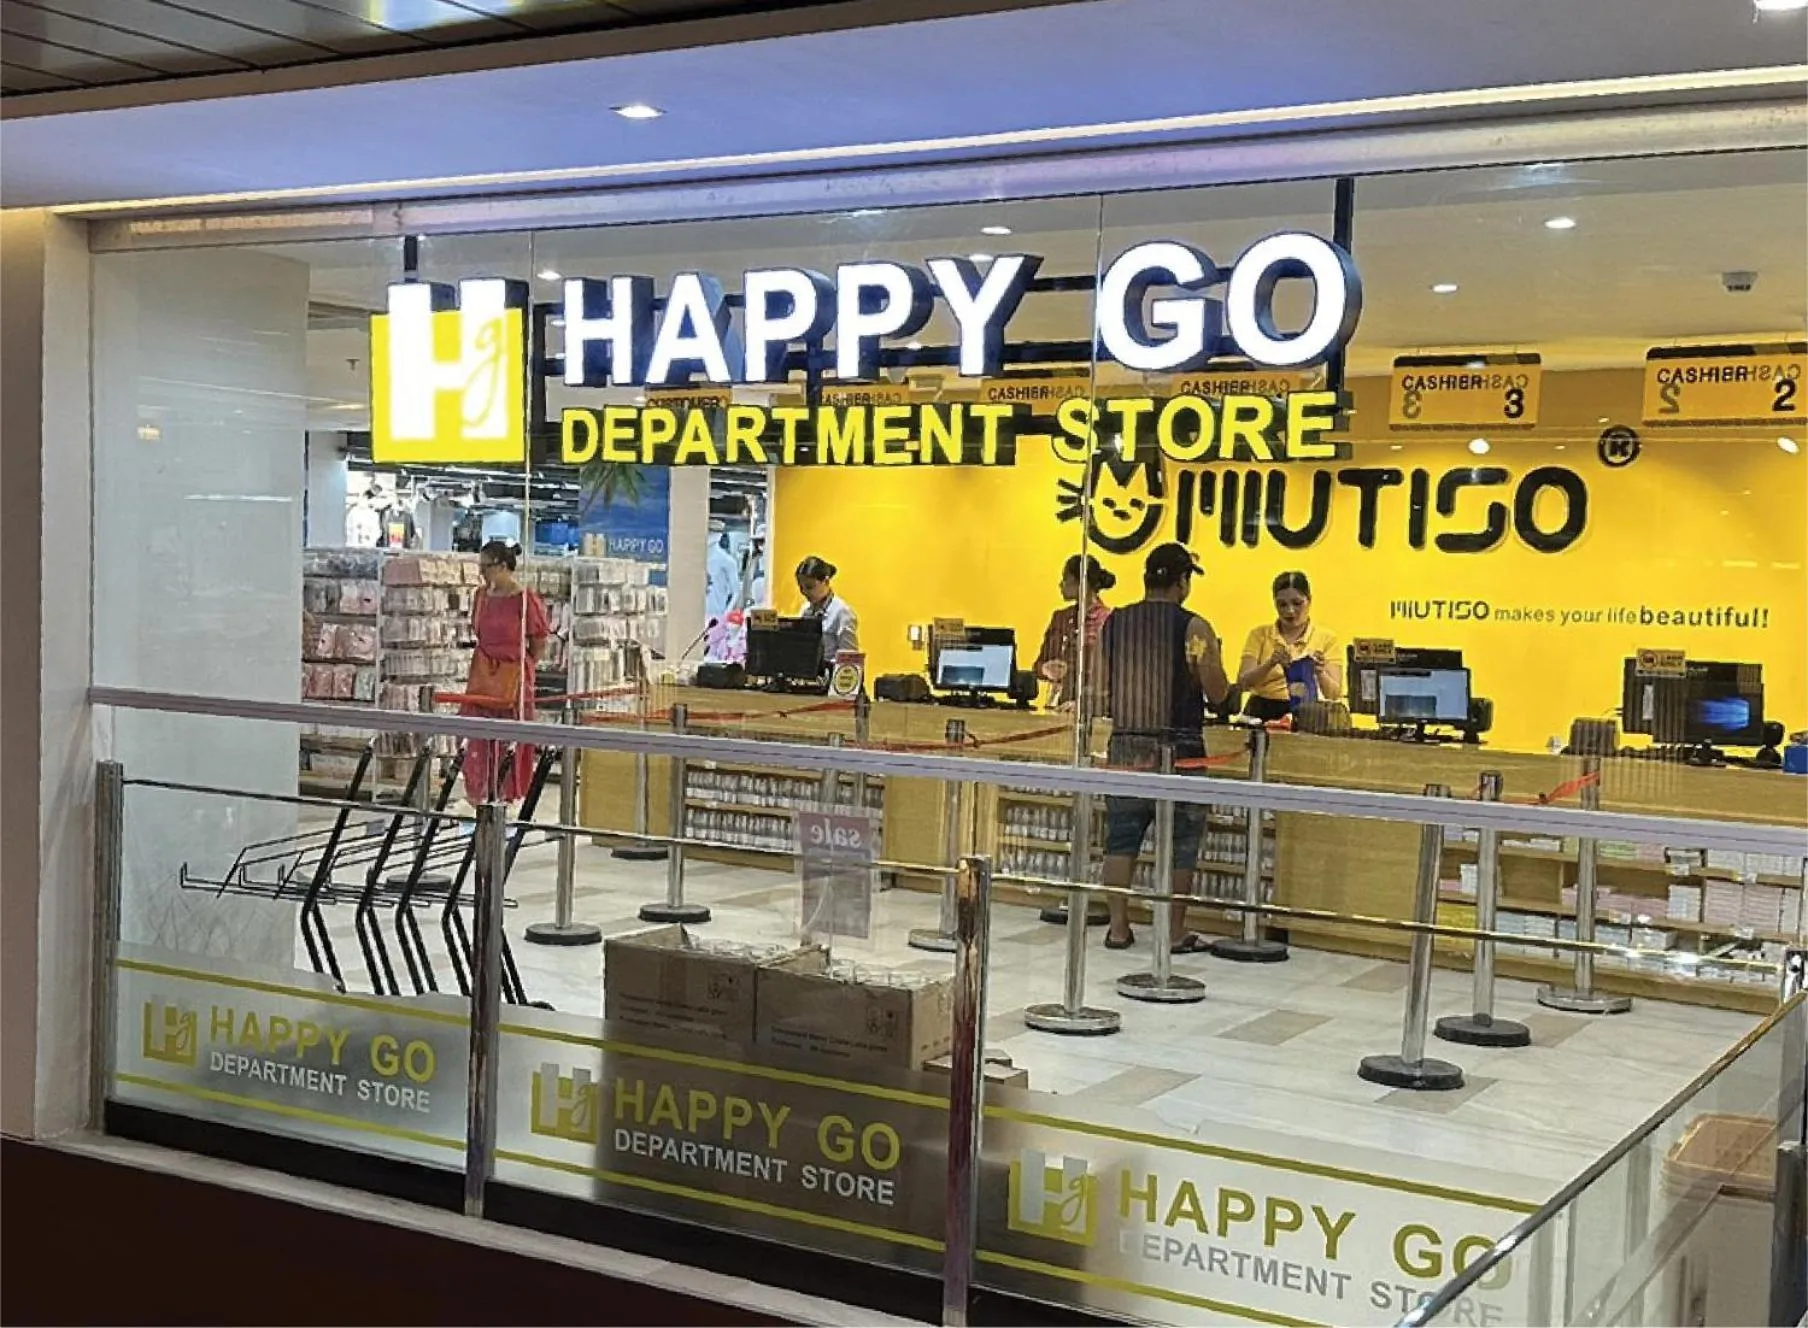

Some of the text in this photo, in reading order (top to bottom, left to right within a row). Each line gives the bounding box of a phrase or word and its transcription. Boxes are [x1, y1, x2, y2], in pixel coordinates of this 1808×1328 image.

[563, 230, 1348, 388] HAPPY GO
[988, 386, 1049, 400] CASHIER
[1401, 373, 1482, 390] CASHIER
[1504, 388, 1525, 419] 3
[1657, 363, 1749, 385] CASHIER
[1771, 378, 1797, 412] 2
[561, 390, 1337, 464] DEPARTMENT STORE
[1494, 606, 1555, 623] makes
[1560, 609, 1604, 627] your
[1607, 606, 1637, 624] life
[1640, 605, 1770, 629] beautiful!
[210, 1005, 437, 1084] HAPPY GO
[209, 1051, 431, 1114] DEPARTMENT STORE
[614, 1077, 901, 1170] HAPPY GO
[614, 1128, 896, 1206] DEPARTMENT STORE
[1120, 1168, 1513, 1290] HAPPY GO
